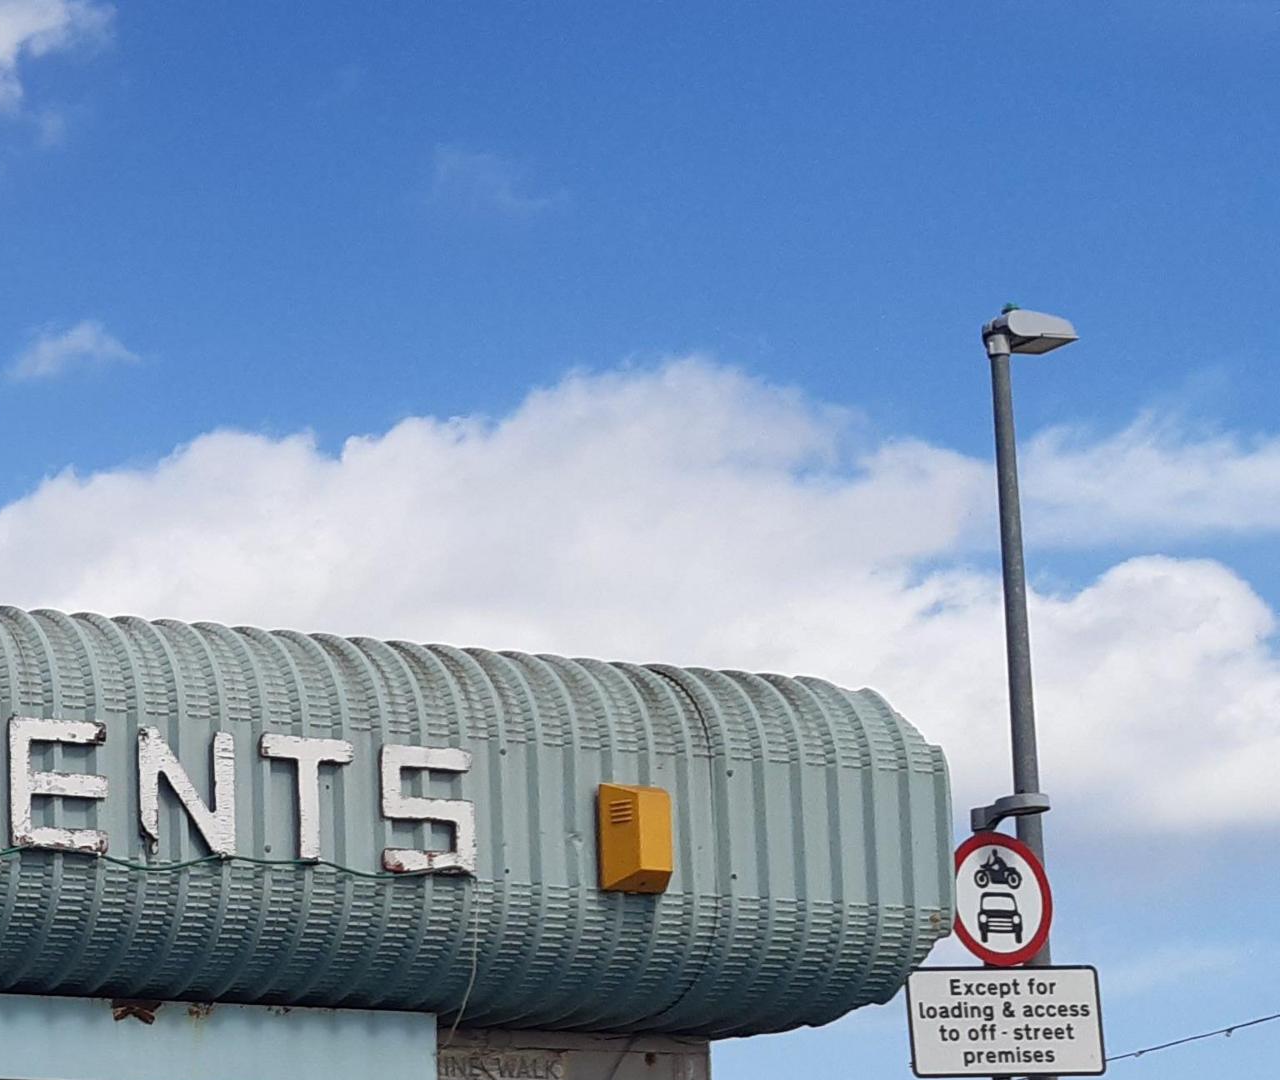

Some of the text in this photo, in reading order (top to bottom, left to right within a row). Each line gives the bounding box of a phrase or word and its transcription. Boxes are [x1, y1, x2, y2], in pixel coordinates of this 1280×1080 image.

[949, 978, 1056, 998] Except for
[919, 1001, 1091, 1021] loading & access
[939, 1024, 960, 1041] to
[963, 1046, 1056, 1067] premises
[442, 1055, 560, 1080] INE WALK
